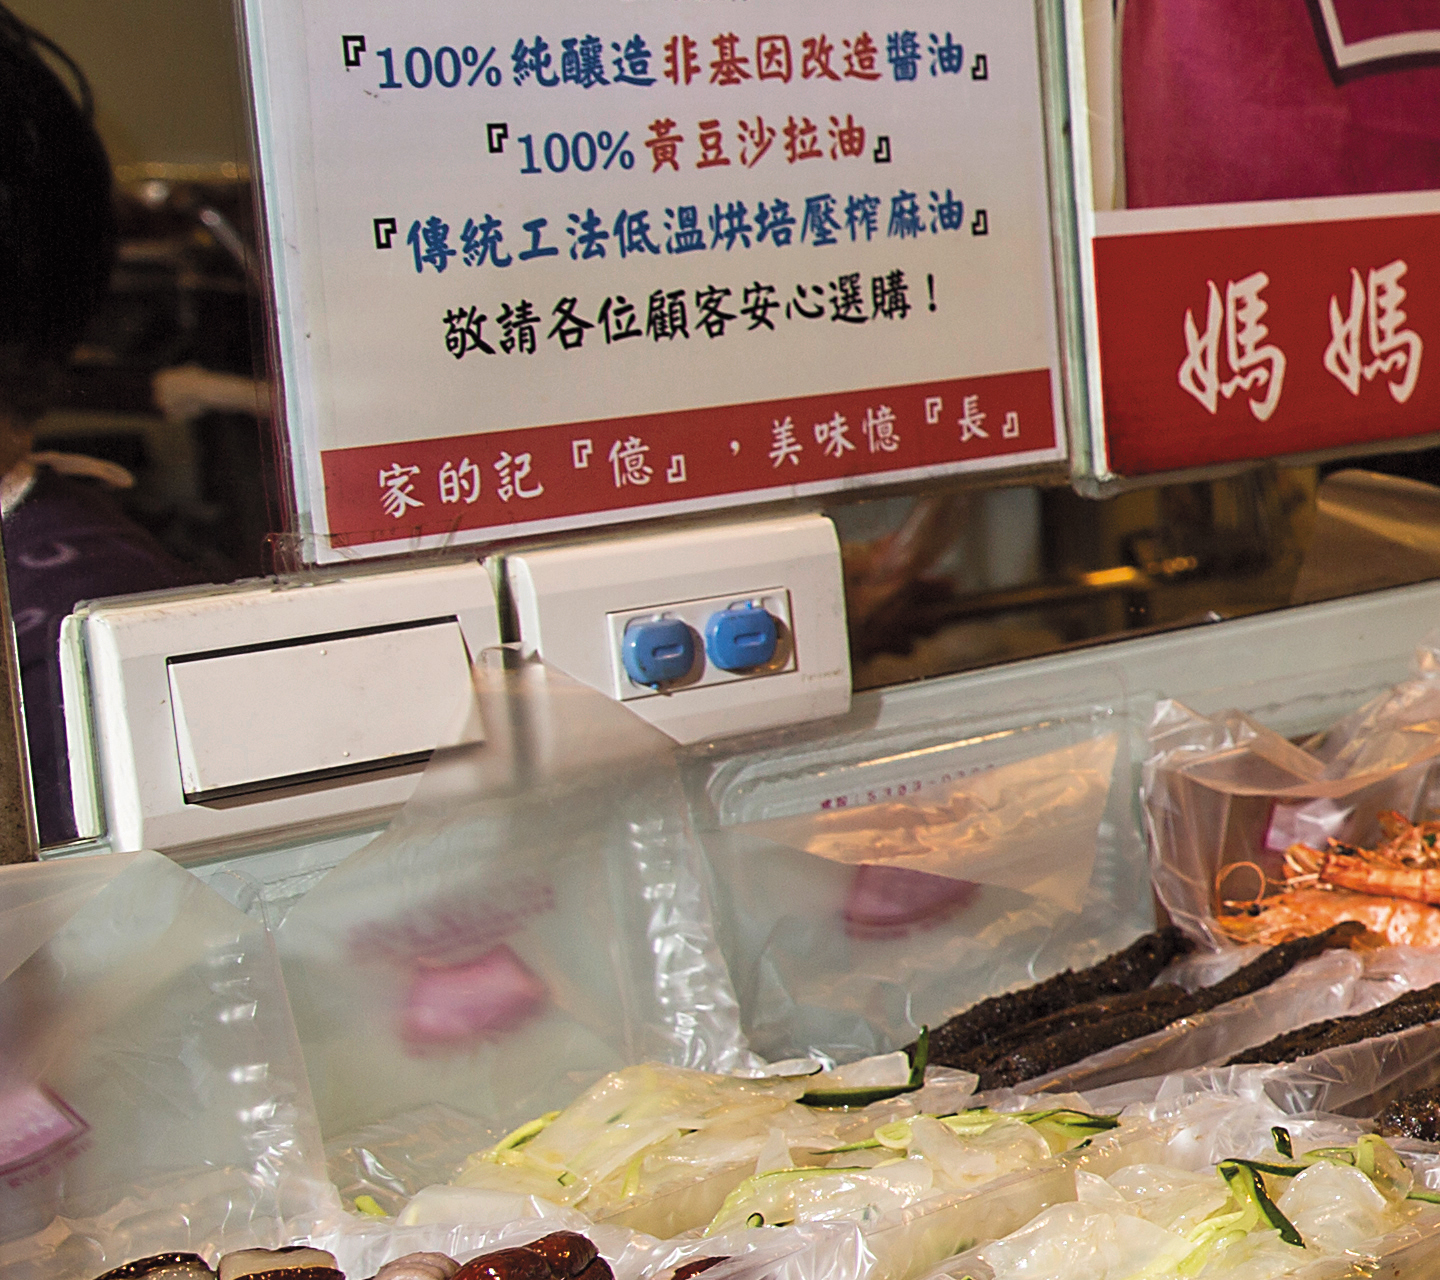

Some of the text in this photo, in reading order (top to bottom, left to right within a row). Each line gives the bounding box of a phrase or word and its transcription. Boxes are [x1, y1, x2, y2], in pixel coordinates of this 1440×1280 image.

[374, 189, 989, 273] 『傳統工法低溫烘培壓榨麻油』
[443, 270, 940, 360] 敬請各位顧客安心選購！
